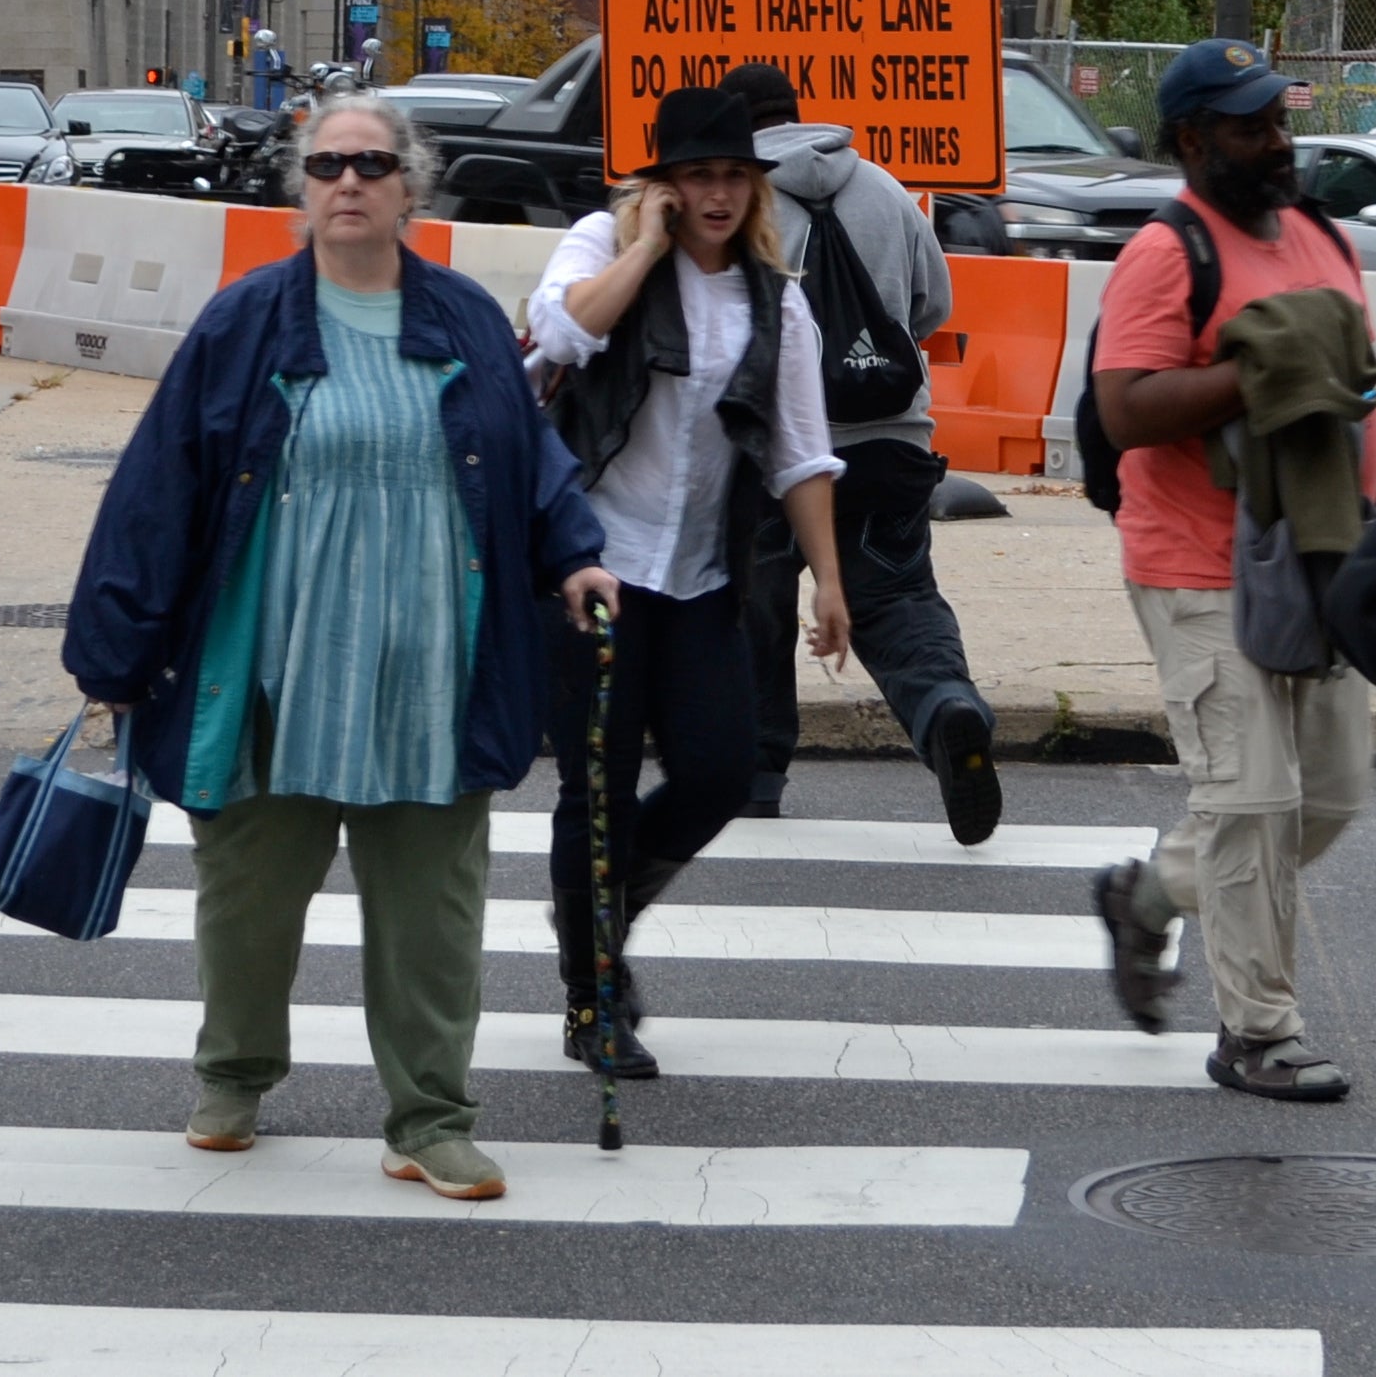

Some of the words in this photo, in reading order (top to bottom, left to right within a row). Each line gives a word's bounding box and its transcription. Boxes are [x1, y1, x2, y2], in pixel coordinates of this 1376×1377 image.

[632, 55, 666, 98] DO
[680, 54, 730, 90] NOT
[831, 55, 856, 100] IN
[871, 54, 970, 101] STREET
[866, 126, 893, 165] TO
[900, 126, 960, 165] FINES
